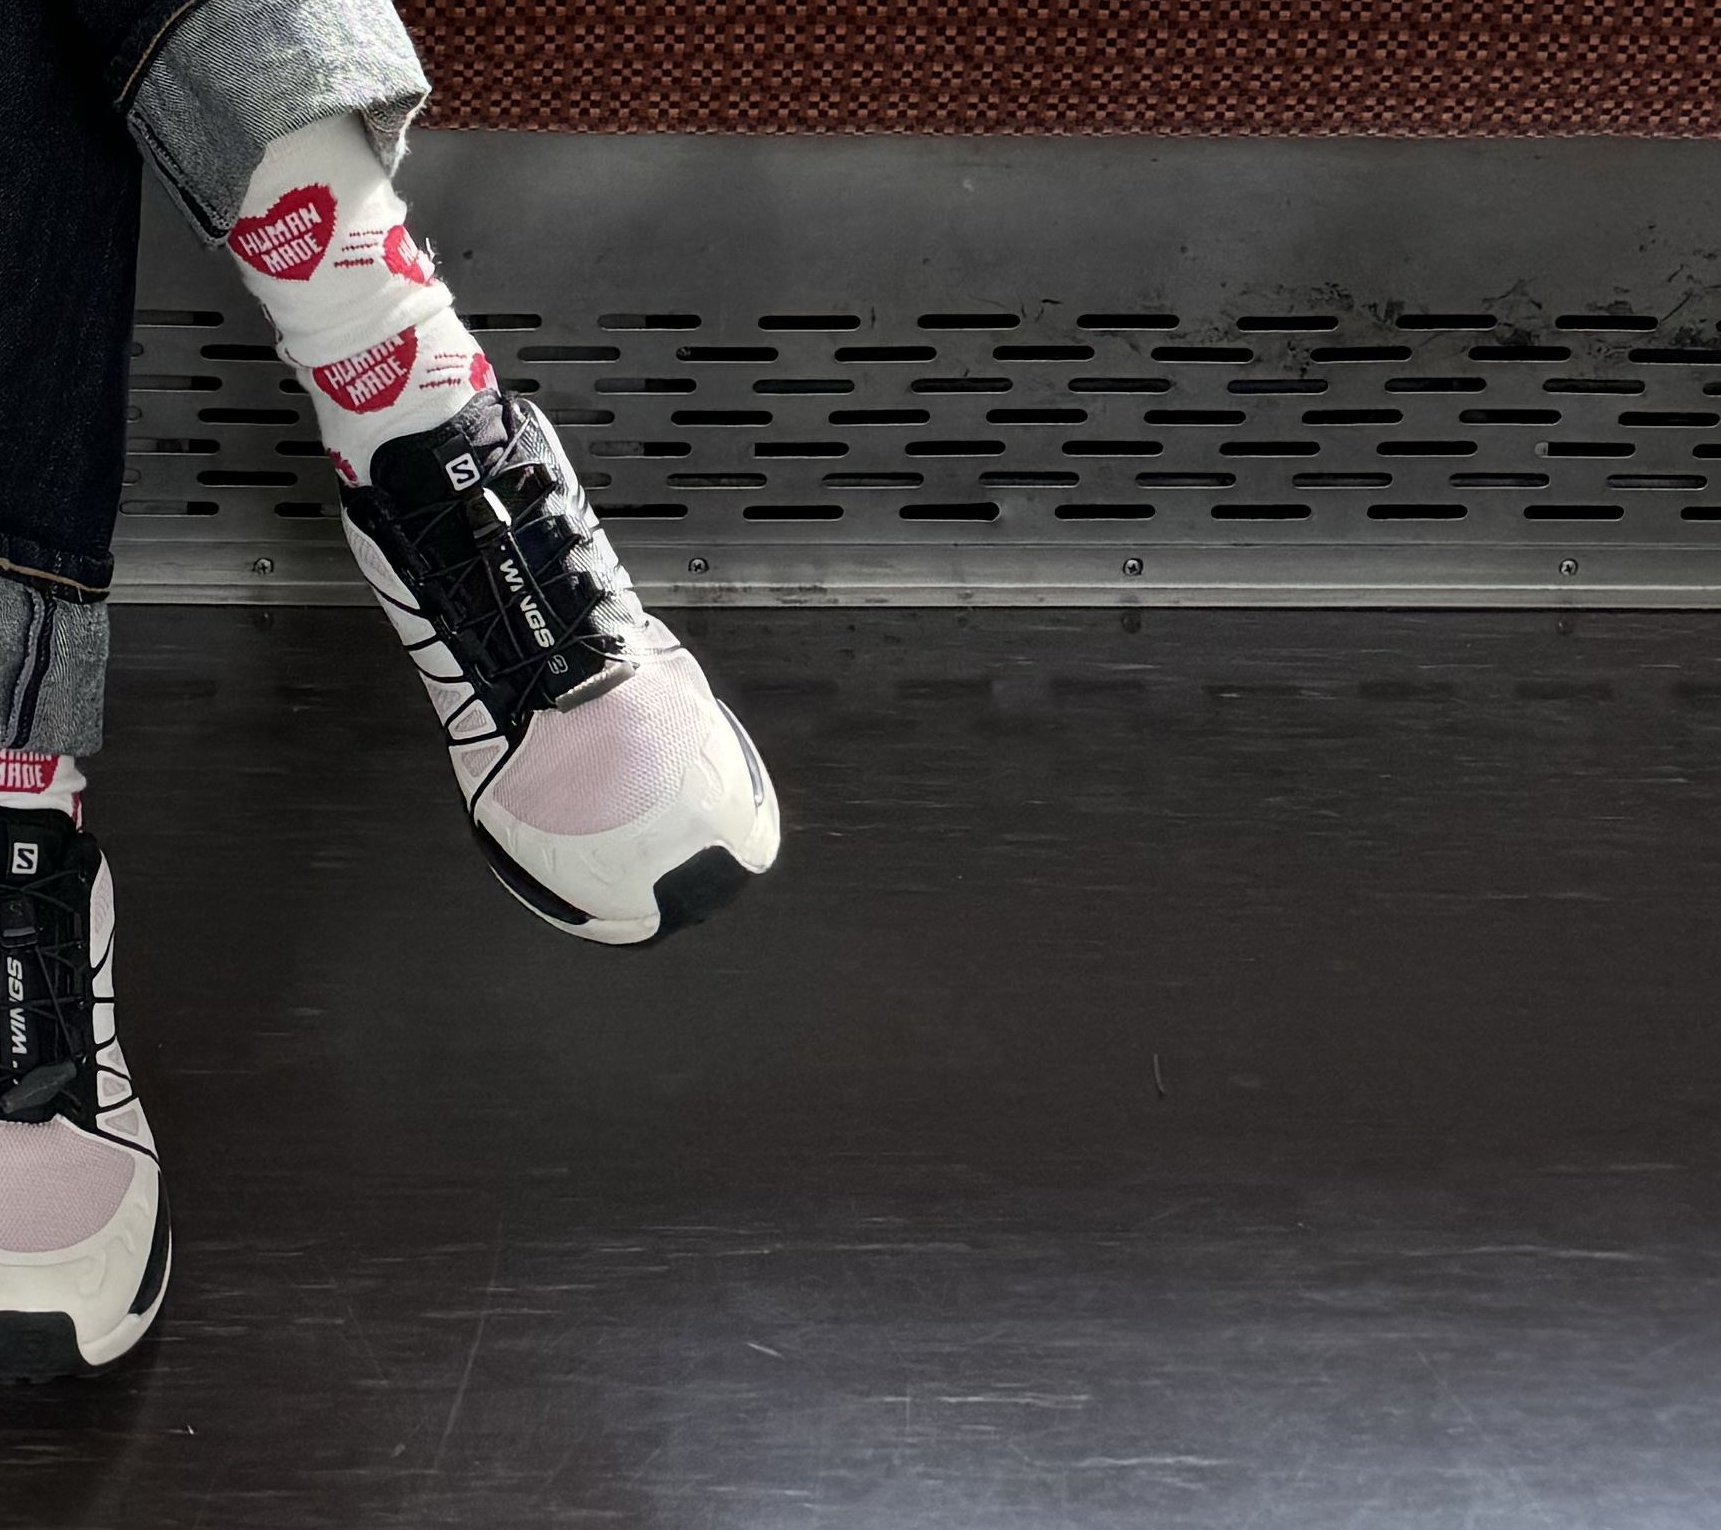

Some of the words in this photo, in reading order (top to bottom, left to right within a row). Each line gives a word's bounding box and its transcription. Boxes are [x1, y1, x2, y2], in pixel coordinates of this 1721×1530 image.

[238, 202, 323, 257] HUMAN
[261, 232, 324, 274] MADE
[346, 356, 409, 408] MADE
[15, 845, 36, 871] S
